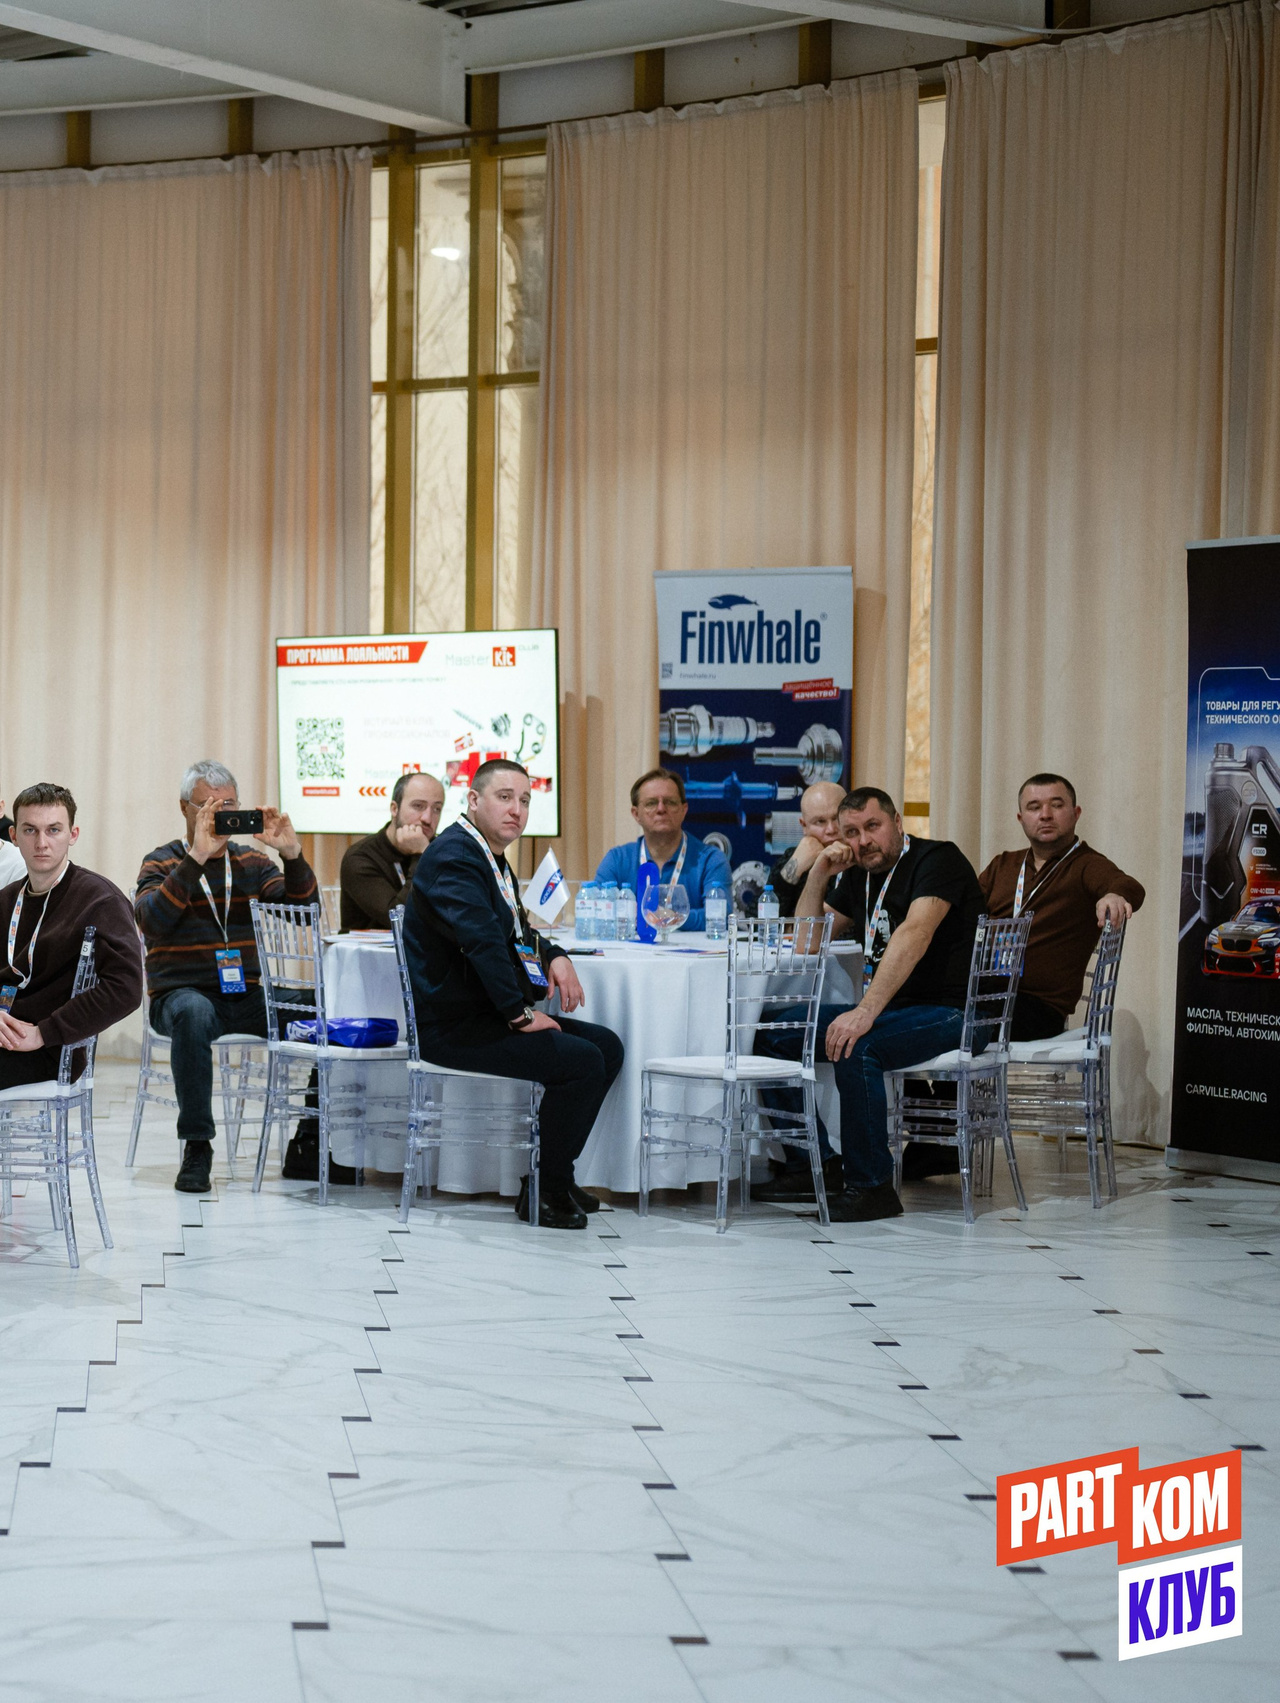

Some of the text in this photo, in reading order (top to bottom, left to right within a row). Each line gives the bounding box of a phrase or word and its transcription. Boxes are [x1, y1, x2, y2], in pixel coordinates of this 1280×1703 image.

[680, 609, 821, 664] Finwhale
[286, 645, 410, 664] ПРОГРАММА ЛОЯЛЬНОСТИ
[494, 646, 514, 666] Kit
[795, 688, 837, 699] качество!
[1206, 701, 1240, 711] ТОВАРЫ
[1241, 701, 1260, 712] ДЛЯ
[1205, 714, 1270, 724] ТЕХНИЧЕСКОГО
[1251, 823, 1268, 835] CR
[978, 931, 984, 939] 6
[82, 944, 89, 952] 5
[1186, 1006, 1224, 1021] МАСЛА,
[1186, 1022, 1235, 1038] ФИЛЬТРЫ,
[1185, 1083, 1268, 1103] CARVILLE.RACING
